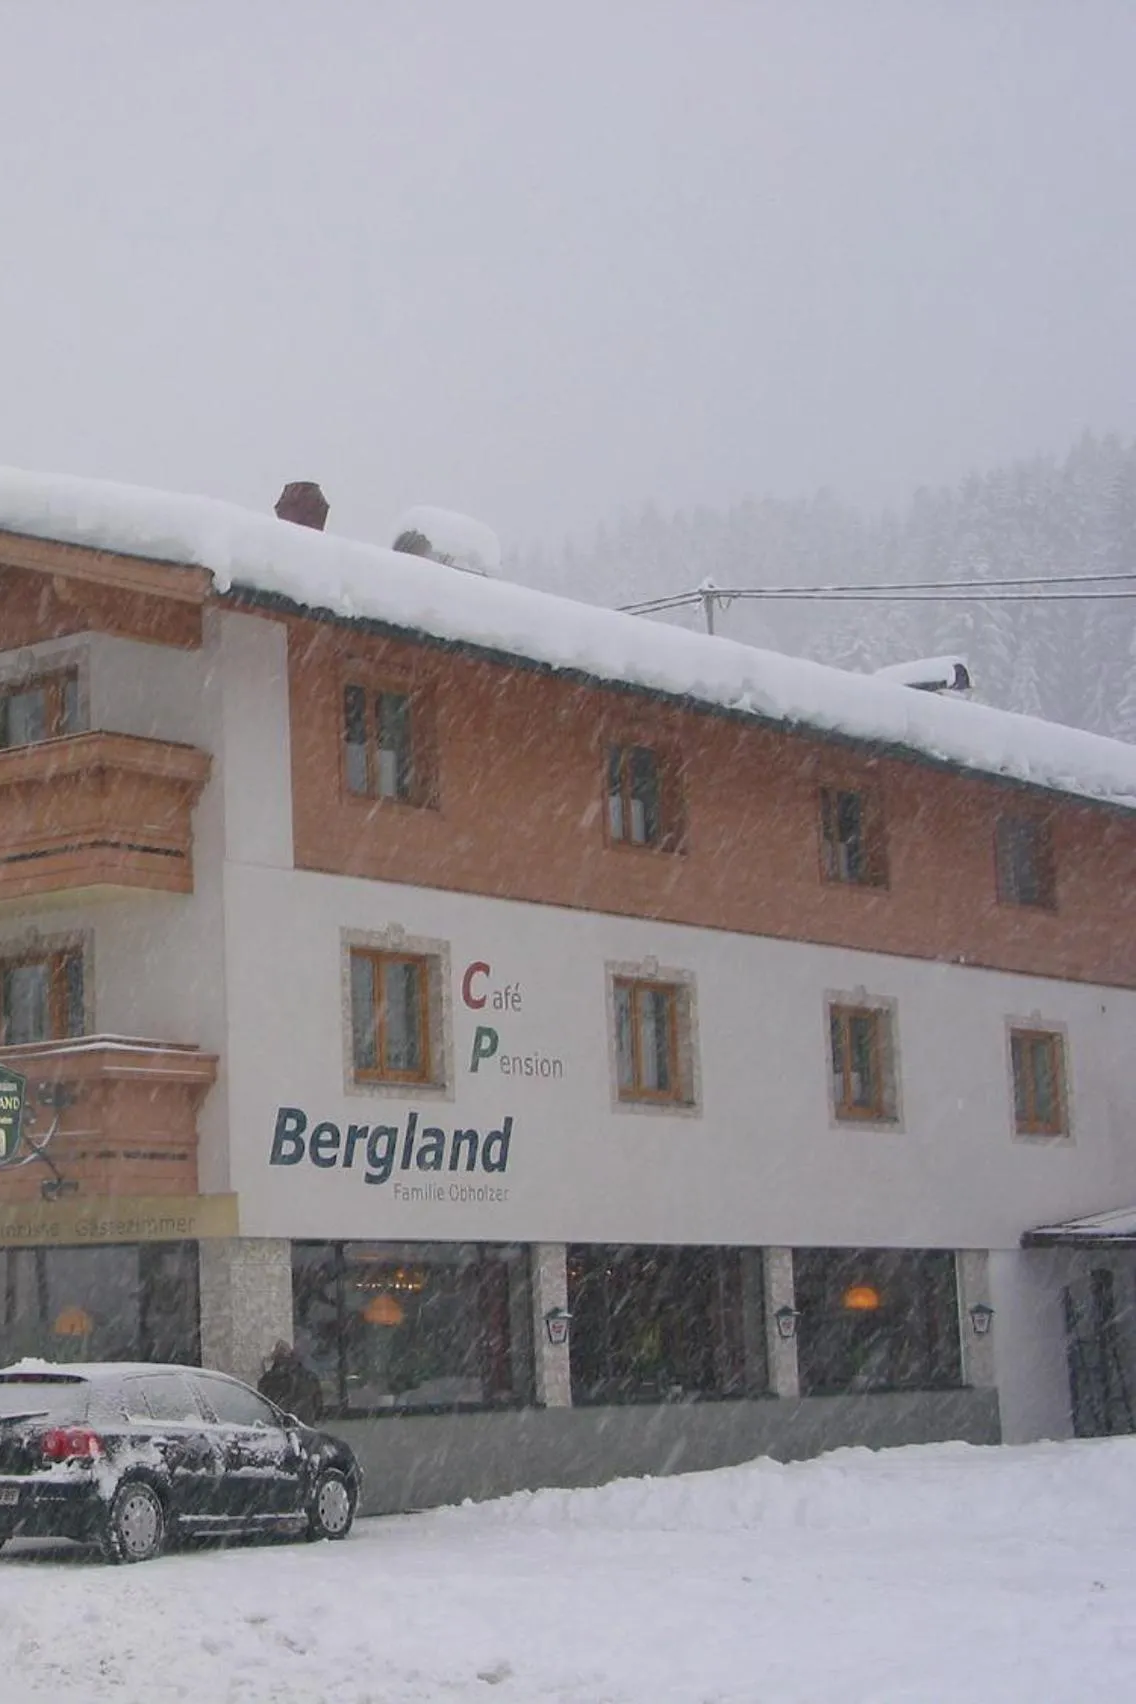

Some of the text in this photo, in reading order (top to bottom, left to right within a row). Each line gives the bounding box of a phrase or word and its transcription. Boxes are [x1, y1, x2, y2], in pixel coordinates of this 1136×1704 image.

[462, 961, 522, 1012] Café
[469, 1026, 564, 1078] Pension
[269, 1107, 514, 1185] Bergland
[393, 1183, 510, 1203] Familie Obholzer
